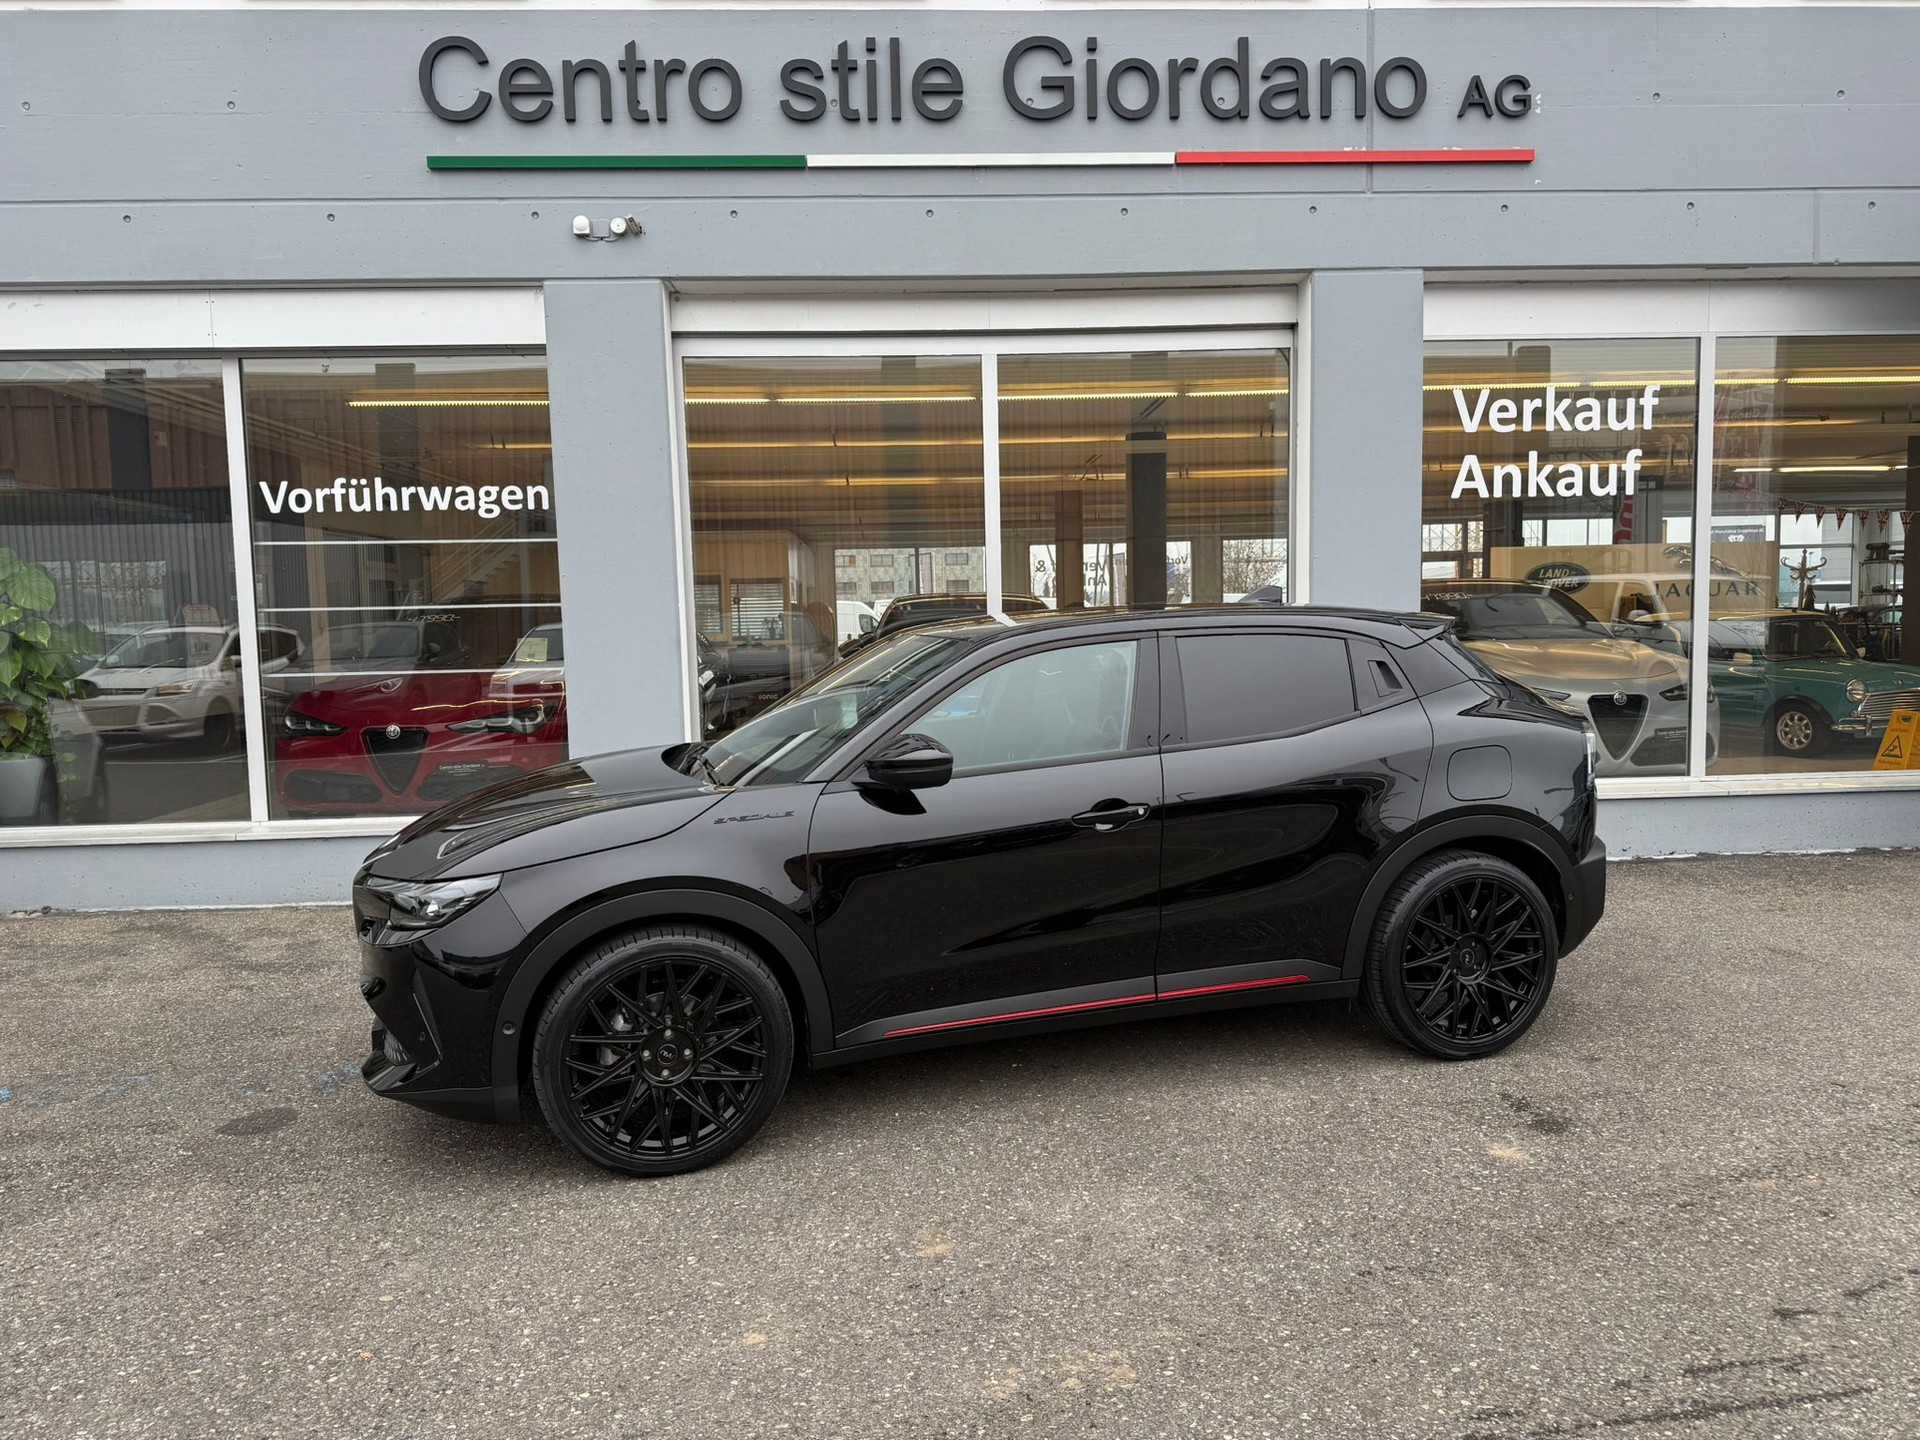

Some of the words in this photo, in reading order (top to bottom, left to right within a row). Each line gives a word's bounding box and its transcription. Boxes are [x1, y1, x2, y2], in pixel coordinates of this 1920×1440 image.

[418, 36, 742, 123] Centro
[779, 37, 964, 123] stile
[1003, 35, 1428, 121] Giordano
[1457, 75, 1532, 119] AG
[1452, 384, 1661, 433] Verkauf
[258, 477, 550, 519] Vorführwagen
[1451, 448, 1642, 499] Ankauf
